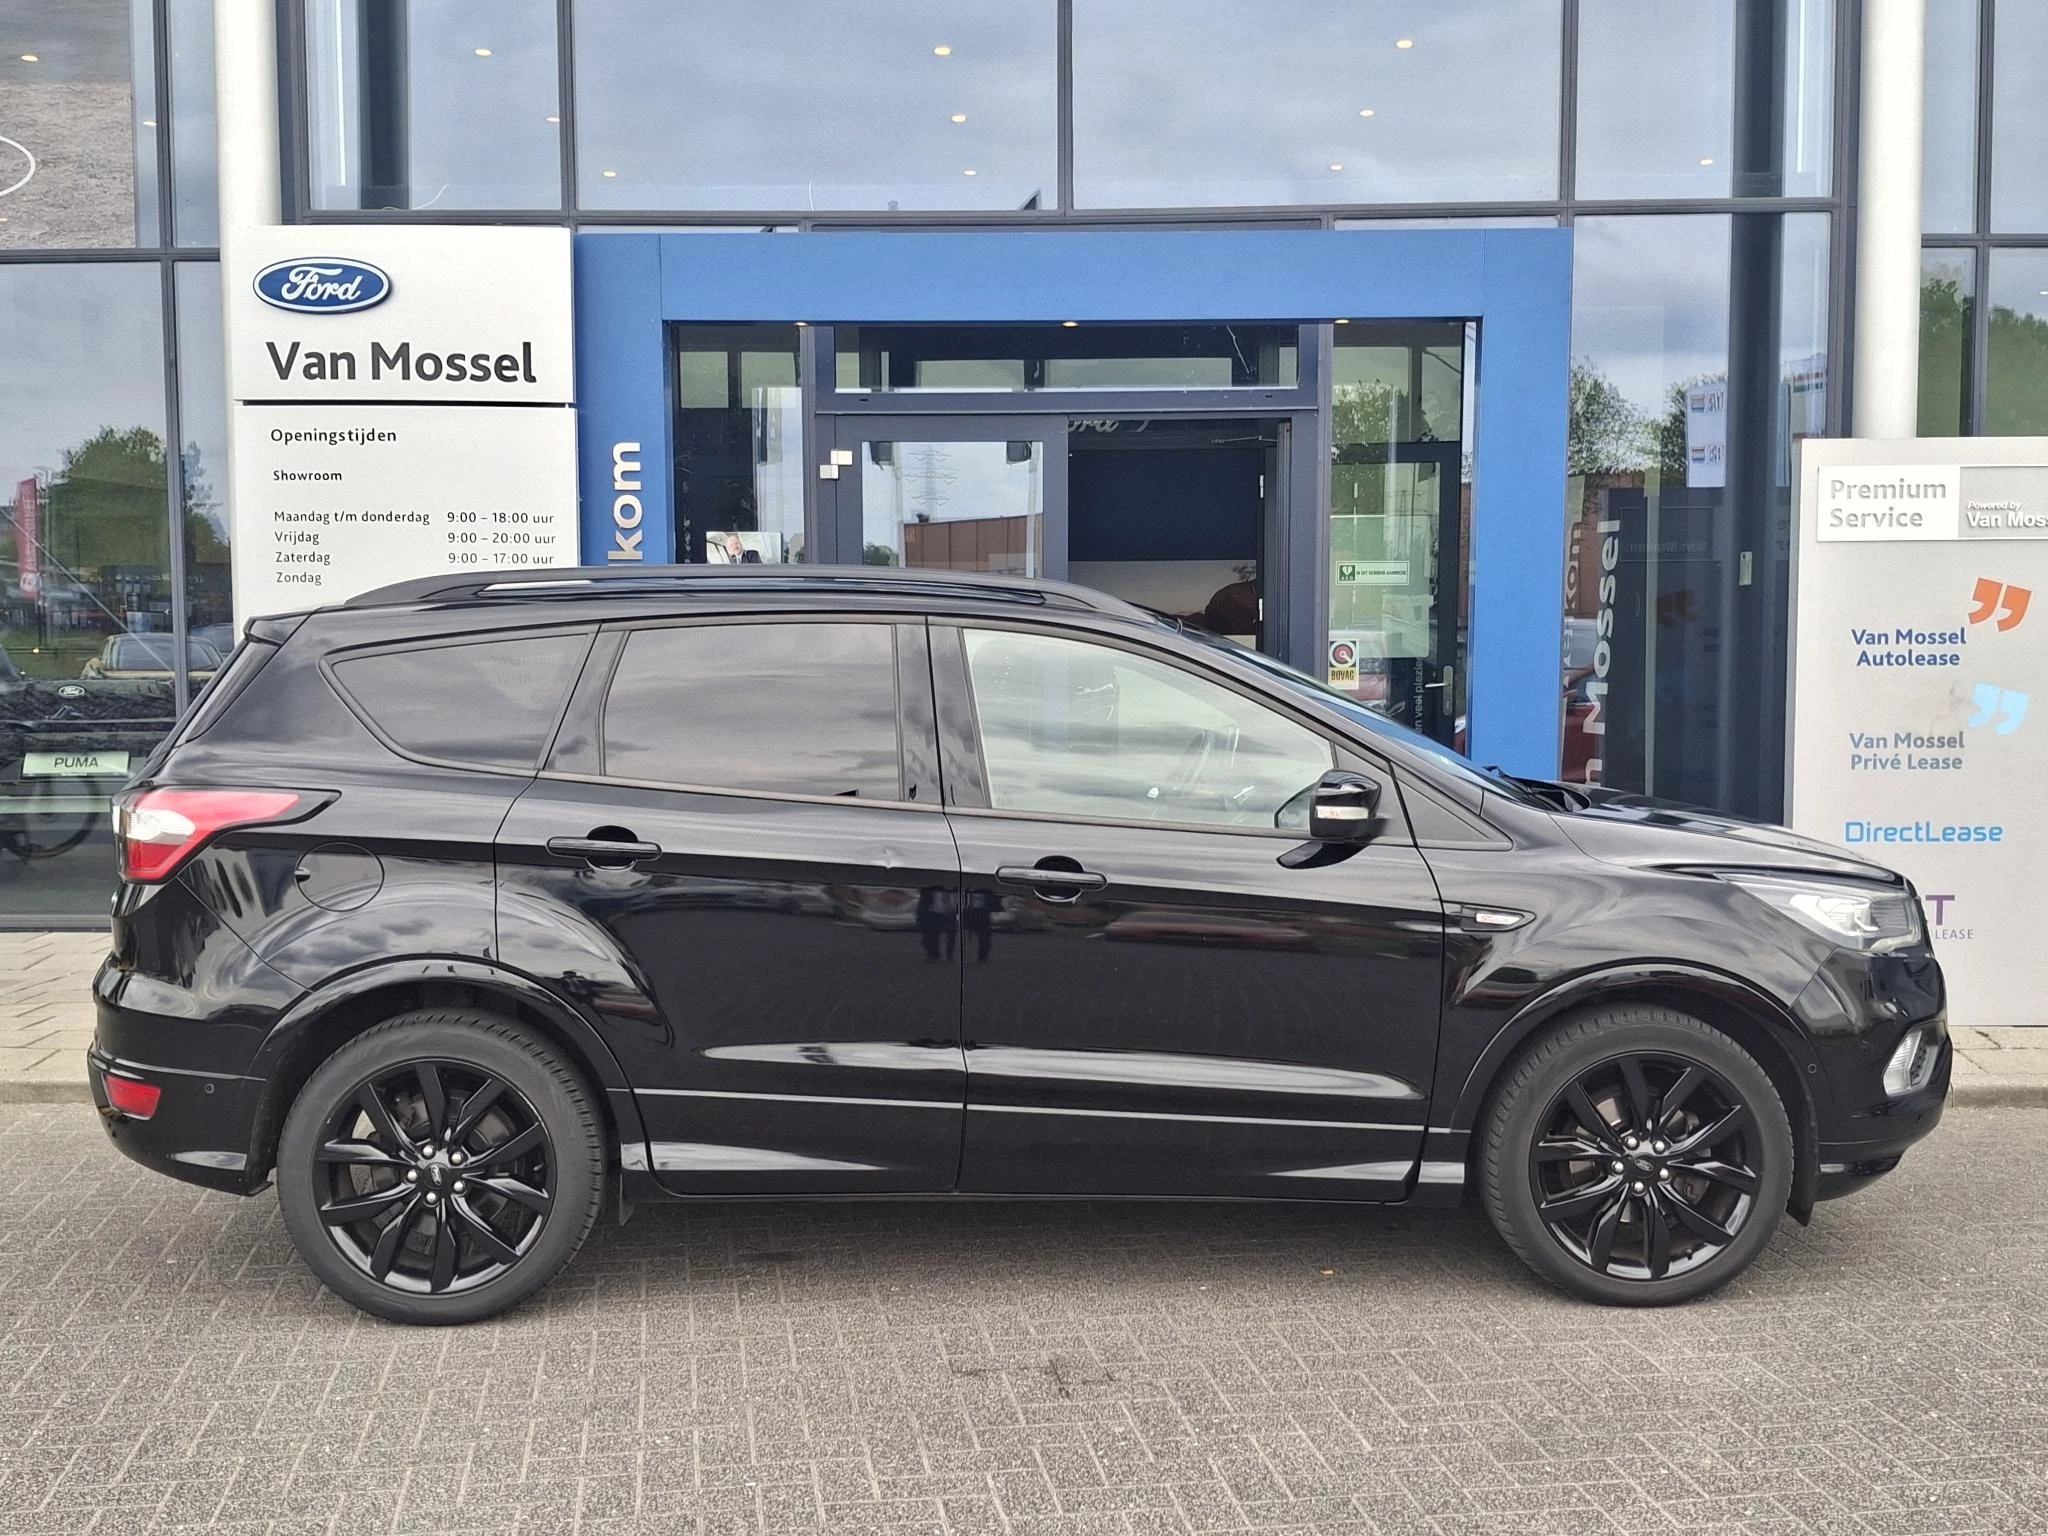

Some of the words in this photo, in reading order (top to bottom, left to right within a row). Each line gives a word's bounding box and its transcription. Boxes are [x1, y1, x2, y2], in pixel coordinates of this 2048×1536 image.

[281, 265, 362, 300] Ford
[266, 341, 356, 381] Van
[370, 341, 537, 383] Mossel
[271, 428, 397, 446] Openingstijden
[273, 469, 343, 481] Showroom
[1831, 477, 1947, 500] Premium
[608, 442, 643, 566] kom
[1967, 501, 2008, 510] Powered
[2010, 501, 2021, 512] by
[274, 510, 330, 525] Maandag
[334, 511, 357, 523] t/m
[361, 511, 430, 526] donderdag
[447, 512, 477, 523] 9:00
[492, 512, 529, 524] 18:00
[533, 515, 555, 524] uur
[1829, 506, 1923, 528] Service
[1967, 511, 2000, 527] Van
[2007, 511, 2048, 527] Mos
[274, 531, 320, 546] Vrijdag
[447, 532, 477, 544] 9:00
[492, 532, 530, 544] 20:00
[534, 535, 556, 544] uur
[275, 551, 331, 566] Zaterdag
[448, 553, 478, 564] 9:00
[493, 553, 529, 564] 17:00
[533, 556, 555, 564] uur
[276, 571, 322, 585] Zondag
[1583, 519, 1621, 735] Mossel
[1851, 628, 1889, 646] Van
[1896, 627, 1967, 645] Mossel
[1856, 649, 1961, 667] Autolease
[1331, 669, 1355, 681] BOVAG
[1849, 732, 1888, 750] Van
[1893, 730, 1965, 749] Mossel
[54, 756, 99, 768] PUMA
[1850, 752, 1902, 771] Privé
[1907, 753, 1963, 770] Lease
[1845, 821, 2004, 843] DirectLease
[1931, 928, 1974, 940] LEASE
